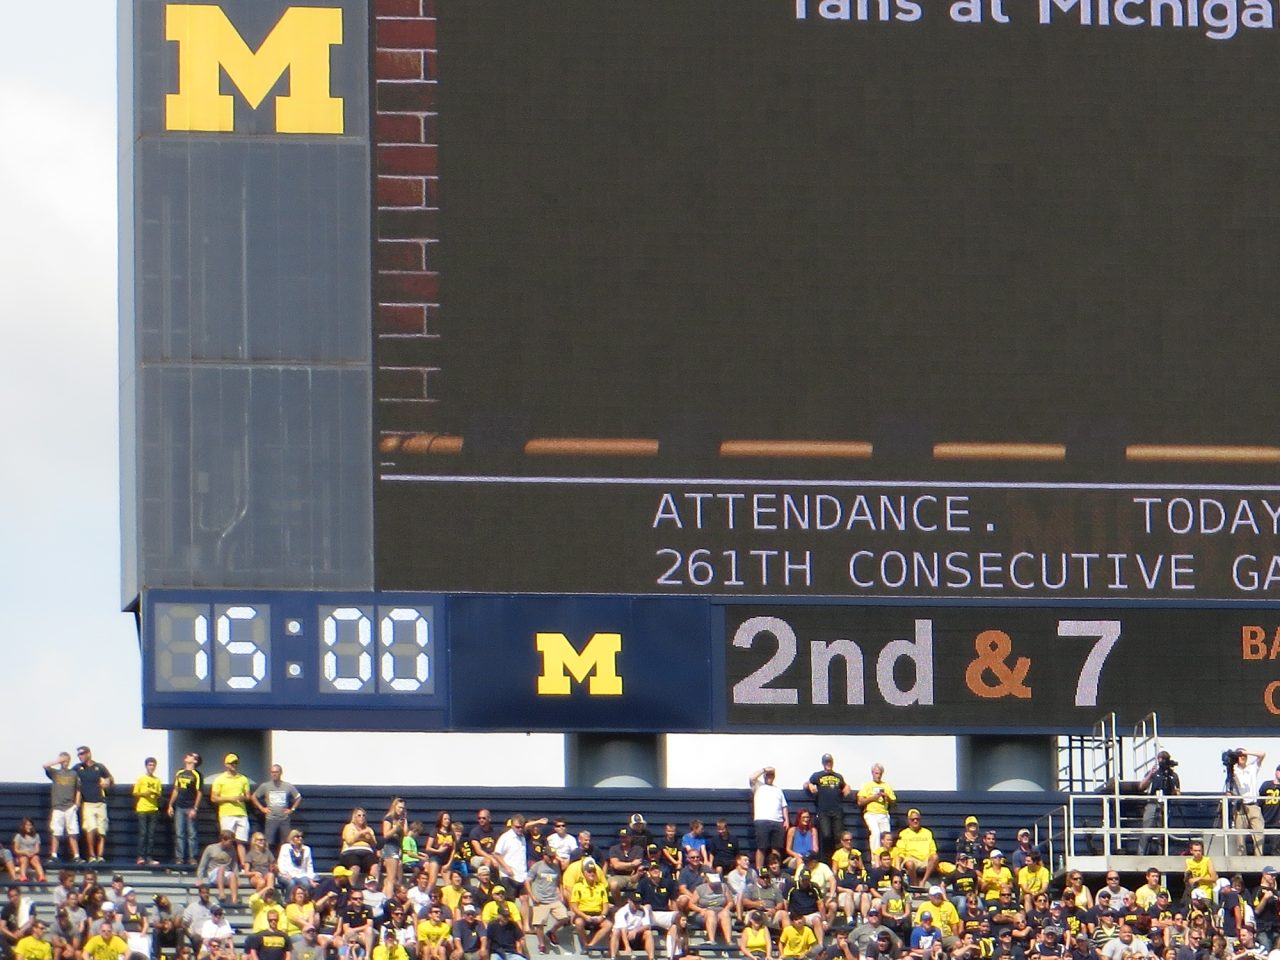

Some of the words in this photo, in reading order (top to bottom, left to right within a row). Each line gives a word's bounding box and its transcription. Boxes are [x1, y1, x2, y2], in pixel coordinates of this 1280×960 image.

[165, 4, 343, 134] M
[652, 493, 997, 533] ATTENDANCE.
[654, 548, 812, 587] 261TH
[848, 550, 1196, 591] CONSECUTIVE
[193, 605, 430, 692] 15:00
[535, 632, 624, 696] M
[732, 615, 934, 708] 2nd
[965, 629, 1032, 699] &
[1057, 620, 1122, 707] 7
